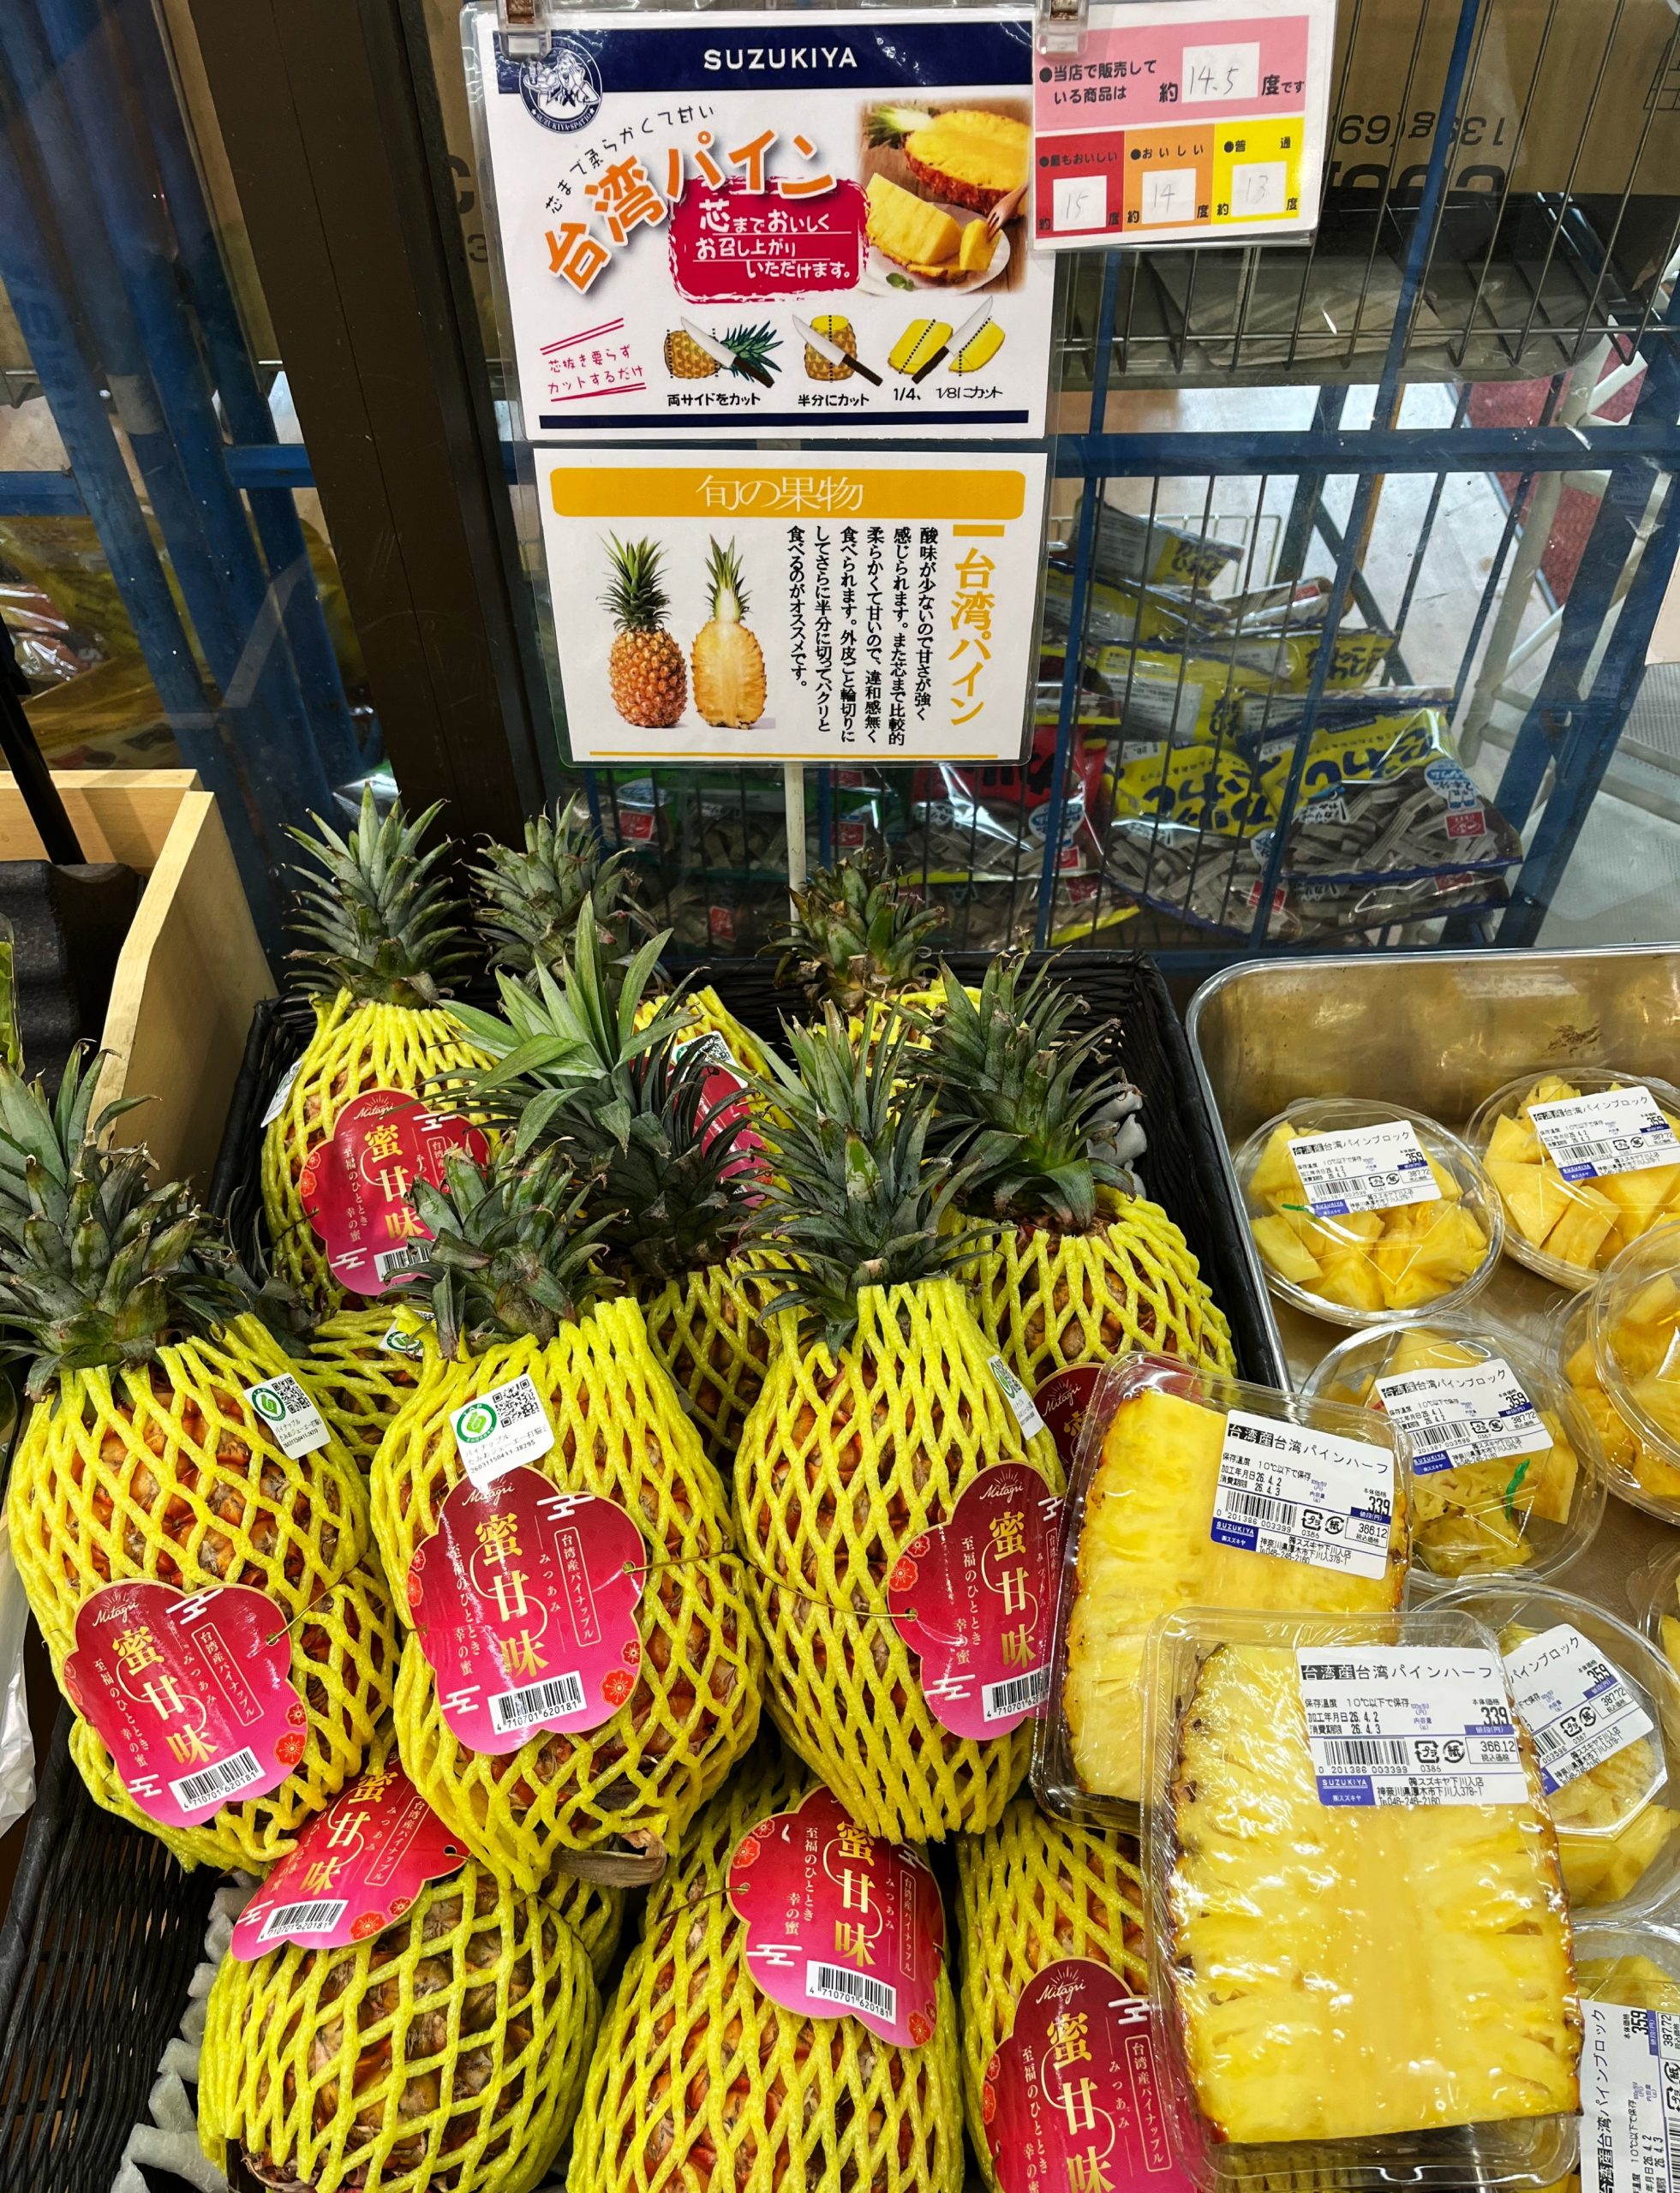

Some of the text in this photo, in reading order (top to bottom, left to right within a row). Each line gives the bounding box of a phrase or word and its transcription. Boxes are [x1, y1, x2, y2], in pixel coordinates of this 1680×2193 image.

[703, 46, 858, 71] SUZUKIYA
[1055, 60, 1157, 82] 当店で販売して
[1055, 86, 1127, 105] いる商品は
[1159, 65, 1305, 103] 約 14.5 度です
[546, 105, 714, 214] 芯まで柔らかくて甘い
[1050, 152, 1117, 167] 最もおいしい
[545, 129, 836, 291] 台湾パイン
[1039, 193, 1119, 230] 約 15 度
[1127, 182, 1209, 224] 約 14 度
[1217, 175, 1298, 216] 約 13 度
[699, 199, 830, 233] 芯までおいしく
[696, 237, 796, 260] お召し上がり
[746, 260, 851, 279] いただけます。
[547, 344, 631, 373] 芯抜き要らず
[547, 365, 643, 394] カットするだけ
[667, 392, 761, 406] 両サイドをカット
[798, 393, 870, 406] 半分にカット
[696, 474, 864, 513] 旬の果物
[786, 525, 807, 686] 食べるのがオススメです。
[814, 525, 833, 732] してさらに半分に切ってパクリと
[840, 525, 858, 744] 食べられます。外皮ごと輪切りに
[864, 526, 885, 744] 柔らかくて甘いので、違和感無く
[888, 526, 912, 746] 感じられます。また芯まで比較的
[914, 527, 938, 721] 酸味が少ないので甘さが強く
[948, 547, 996, 726] 台湾パイン
[1647, 1114, 1665, 1127] 359
[1405, 1150, 1424, 1164] 359
[1562, 1162, 1590, 1174] SUZUKIYA
[343, 1148, 368, 1227] 至福のひととき
[364, 1124, 426, 1242] 蜜甘味
[1315, 1199, 1343, 1210] SUZUKIYA
[1504, 1391, 1528, 1408] 359
[1511, 1411, 1536, 1424] 387.72
[1229, 1423, 1388, 1473] 台湾産台湾パインハーフ
[1413, 1452, 1446, 1467] SUZUKIYA
[1221, 1466, 1256, 1480] 加工年月日
[1222, 1453, 1312, 1480] 保存温度 10℃以下で保存
[980, 1480, 1025, 1504] Mitagri
[1362, 1487, 1387, 1497] 本体価格
[1366, 1495, 1391, 1515] 339
[1216, 1521, 1255, 1535] SUZUKIYA
[1226, 1512, 1258, 1525] 201386
[1260, 1520, 1292, 1533] 003399
[1354, 1533, 1379, 1545] 税込価格
[1357, 1522, 1388, 1539] 366.12
[450, 1542, 481, 1656] 至福のひととき
[475, 1514, 550, 1680] 蜜甘味
[539, 1554, 562, 1614] みつあみ
[561, 1533, 595, 1640] 台湾産パイナップル
[960, 1535, 982, 1646] 至福のひととき
[989, 1511, 1037, 1671] 蜜甘味
[92, 1597, 140, 1628] Mitagri
[454, 1626, 474, 1676] 幸の蜜
[1576, 1658, 1598, 1673] 本体価格
[183, 1652, 218, 1707] みつあみ
[200, 1630, 255, 1719] 台湾産パイナップル
[1301, 1664, 1492, 1680] 台湾産台湾パインハーフ
[1585, 1661, 1611, 1686] 359
[93, 1660, 152, 1753] 至福のひととき
[111, 1624, 218, 1768] 蜜甘味
[986, 1698, 1026, 1718] 4 710701
[1305, 1698, 1409, 1708] 保存温度 10℃以下で保存
[1599, 1686, 1627, 1706] 387.72
[497, 1700, 579, 1731] 4 710701 620181
[1307, 1712, 1348, 1722] 加工年月日
[1309, 1724, 1342, 1734] 消費期限
[1480, 1706, 1509, 1725] 339
[121, 1729, 149, 1768] 幸の蜜
[1480, 1741, 1516, 1752] 366.12
[1480, 1753, 1510, 1762] 税込価格
[1540, 1745, 1568, 1764] 003596
[188, 1784, 222, 1806] 710701
[224, 1772, 258, 1793] 620181
[299, 1772, 398, 1896] 蜜甘味
[365, 1807, 397, 1851] みつあみ
[374, 1801, 423, 1881] 台湾産パイナップル
[804, 1827, 818, 1921] 至福のひととき
[834, 1820, 876, 1967] 蜜甘味
[885, 1878, 895, 1930] みつあみ
[267, 1923, 294, 1936] 710701
[296, 1922, 330, 1931] 620181
[784, 1892, 801, 1936] 幸の蜜
[904, 1878, 912, 1973] 台湾産パイナップル
[822, 1988, 856, 2003] 710701
[859, 1999, 890, 2018] 620181
[1035, 1980, 1086, 2005] Mitagri
[1631, 2010, 1649, 2035] 359
[1663, 2014, 1673, 2047] 387.72
[1022, 2045, 1048, 2174] 至福のひととき
[1046, 2012, 1116, 2193] 蜜甘味
[1109, 2060, 1130, 2129] みつあみ
[1132, 2042, 1163, 2166] 台湾産パイナップル
[1592, 2009, 1615, 2193] 台湾産台湾パインブロック
[1628, 2099, 1638, 2163] 10℃以下で保存
